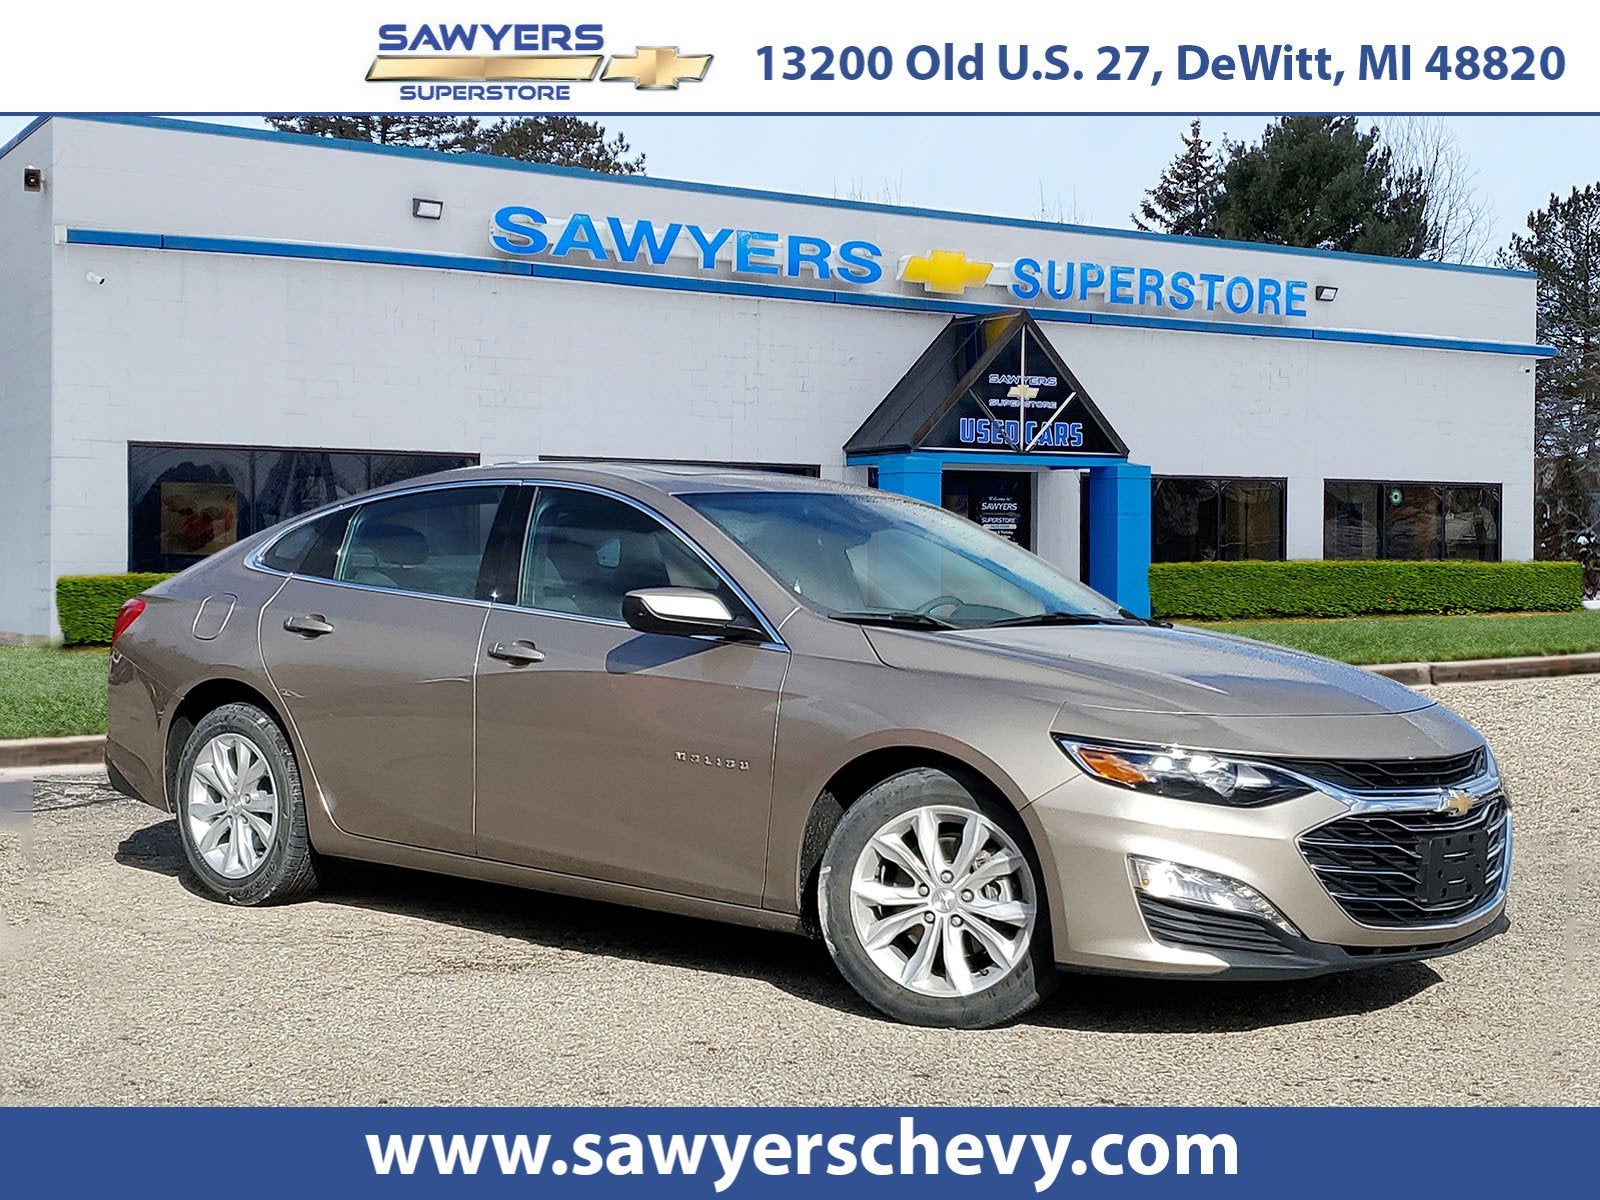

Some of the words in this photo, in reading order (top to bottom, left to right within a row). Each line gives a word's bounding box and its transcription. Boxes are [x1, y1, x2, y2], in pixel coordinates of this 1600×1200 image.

[489, 205, 883, 285] SAWYERS
[1010, 256, 1308, 317] SUPERSTORE
[988, 373, 1058, 387] SAWYERS
[988, 398, 1058, 410] SUPERSTORE
[959, 417, 1020, 445] USED
[1025, 420, 1083, 447] CARS
[981, 502, 1018, 511] SAWYERS
[674, 751, 749, 770] MALIBU
